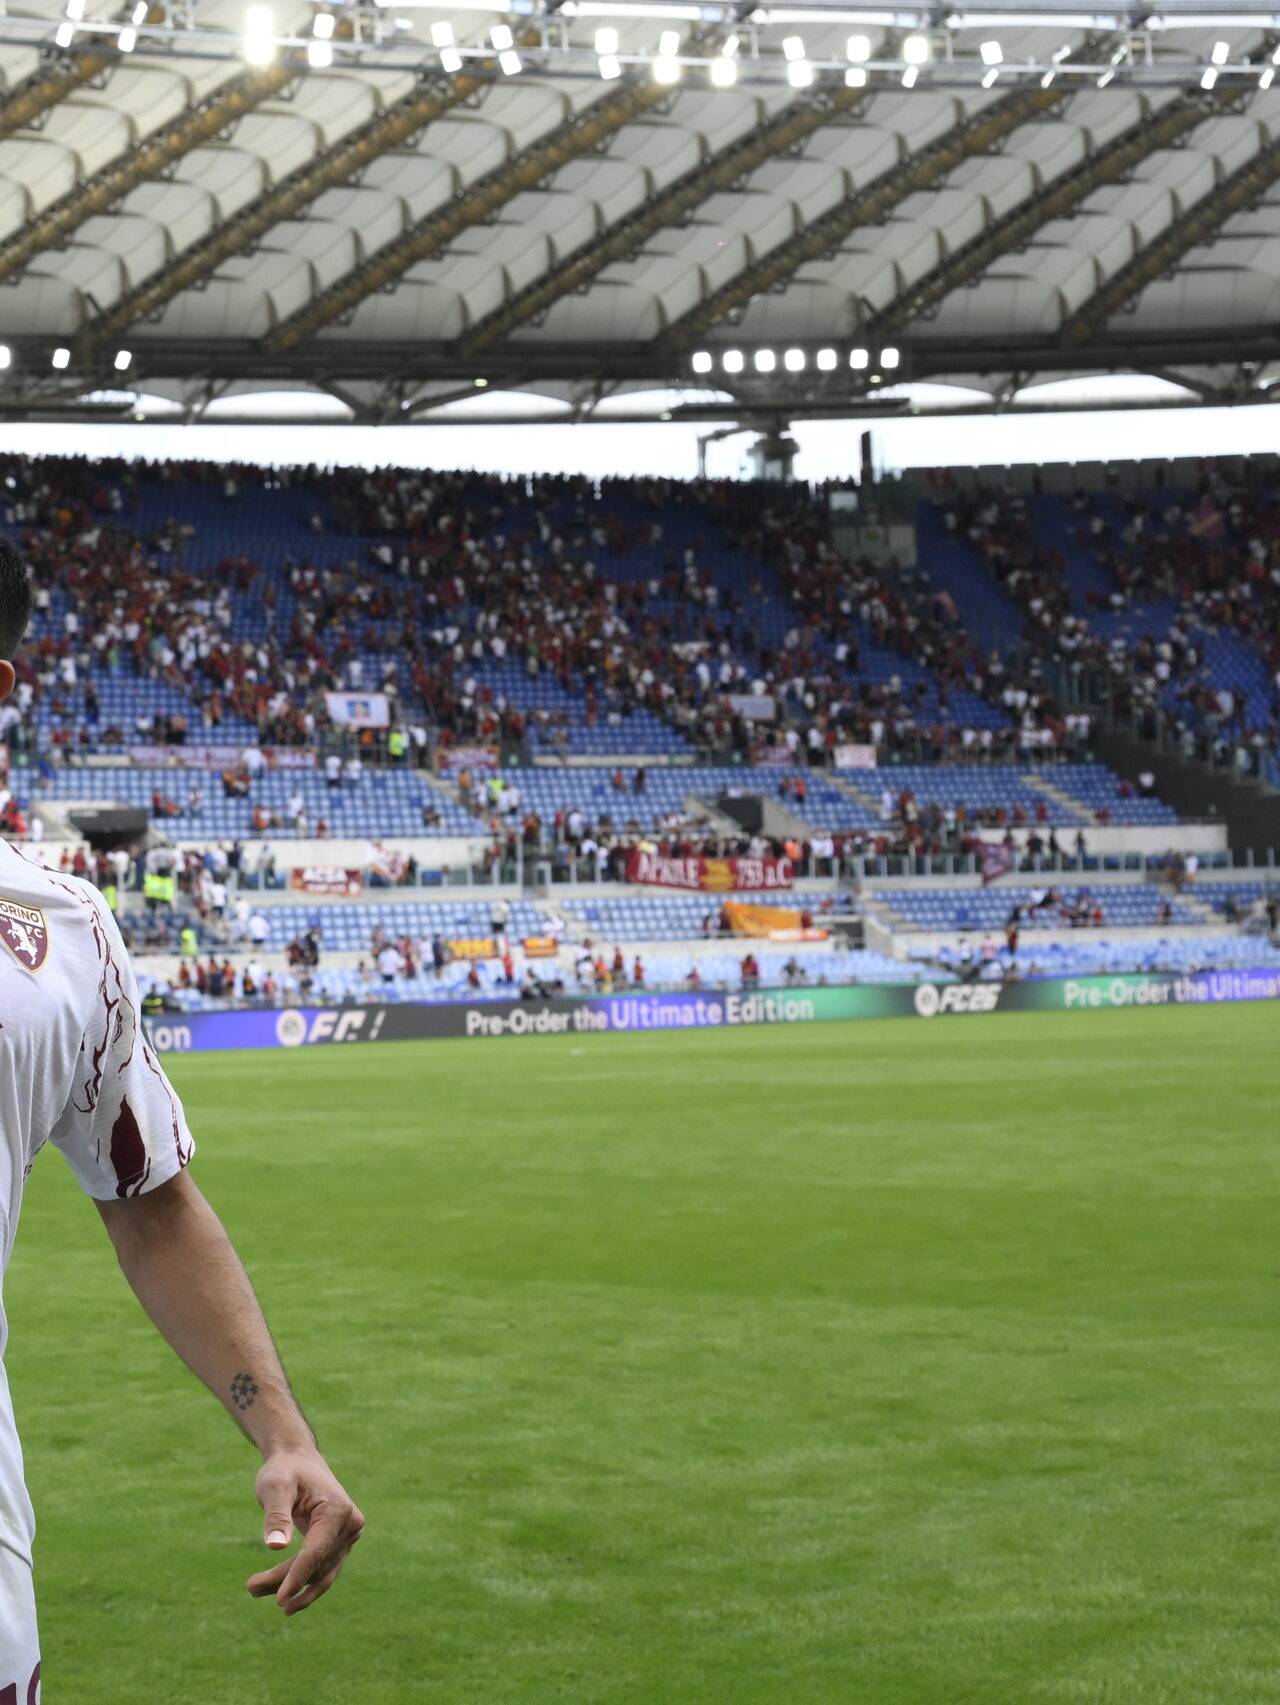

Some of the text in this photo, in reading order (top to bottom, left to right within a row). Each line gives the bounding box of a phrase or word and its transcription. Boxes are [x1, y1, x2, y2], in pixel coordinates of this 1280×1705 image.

[25, 925, 43, 939] FC
[1064, 976, 1171, 1007] Pre-Order
[1174, 974, 1209, 1002] the
[466, 992, 815, 1036] Pre-Order the Ultimate Edition
